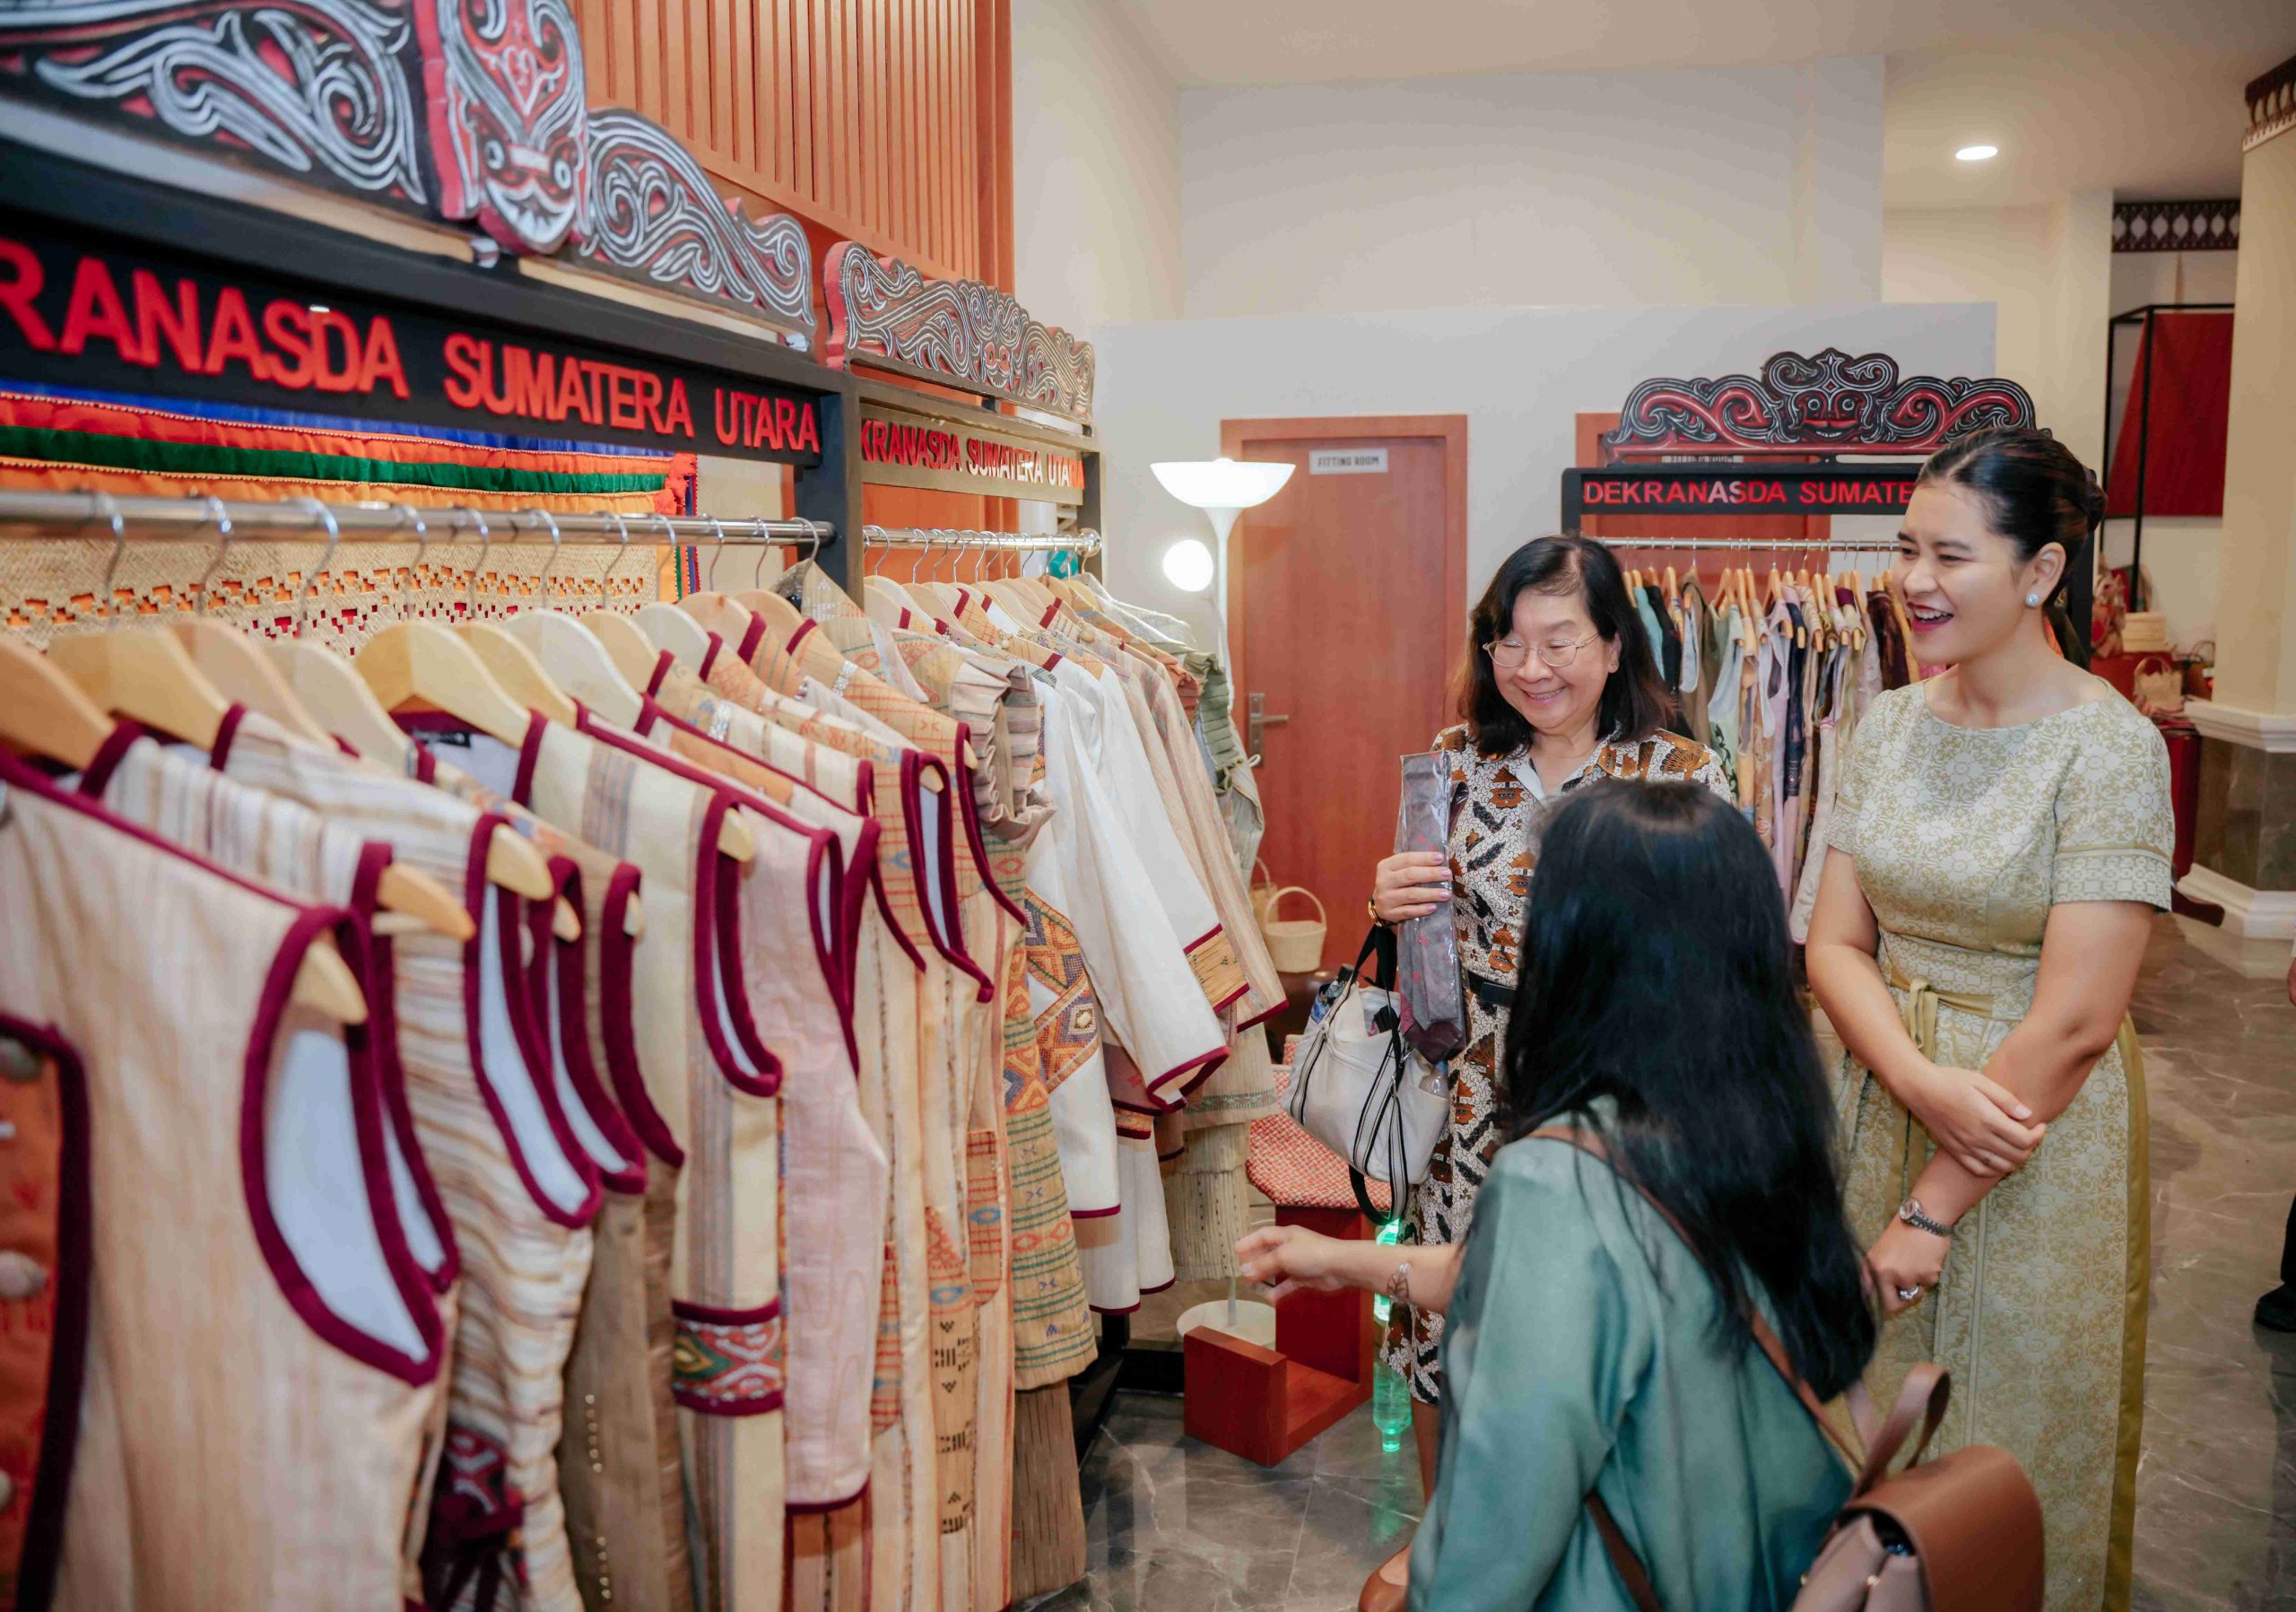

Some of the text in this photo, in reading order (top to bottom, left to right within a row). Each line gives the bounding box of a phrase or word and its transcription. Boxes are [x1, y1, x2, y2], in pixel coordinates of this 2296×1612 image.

[443, 332, 695, 439] SUMATERA
[714, 388, 821, 454] UTARA
[966, 437, 1043, 484] SUMATERA
[1048, 453, 1084, 490] UTARA
[1318, 455, 1378, 466] FITTING ROOM
[1583, 481, 1787, 504] DEKRANASDA
